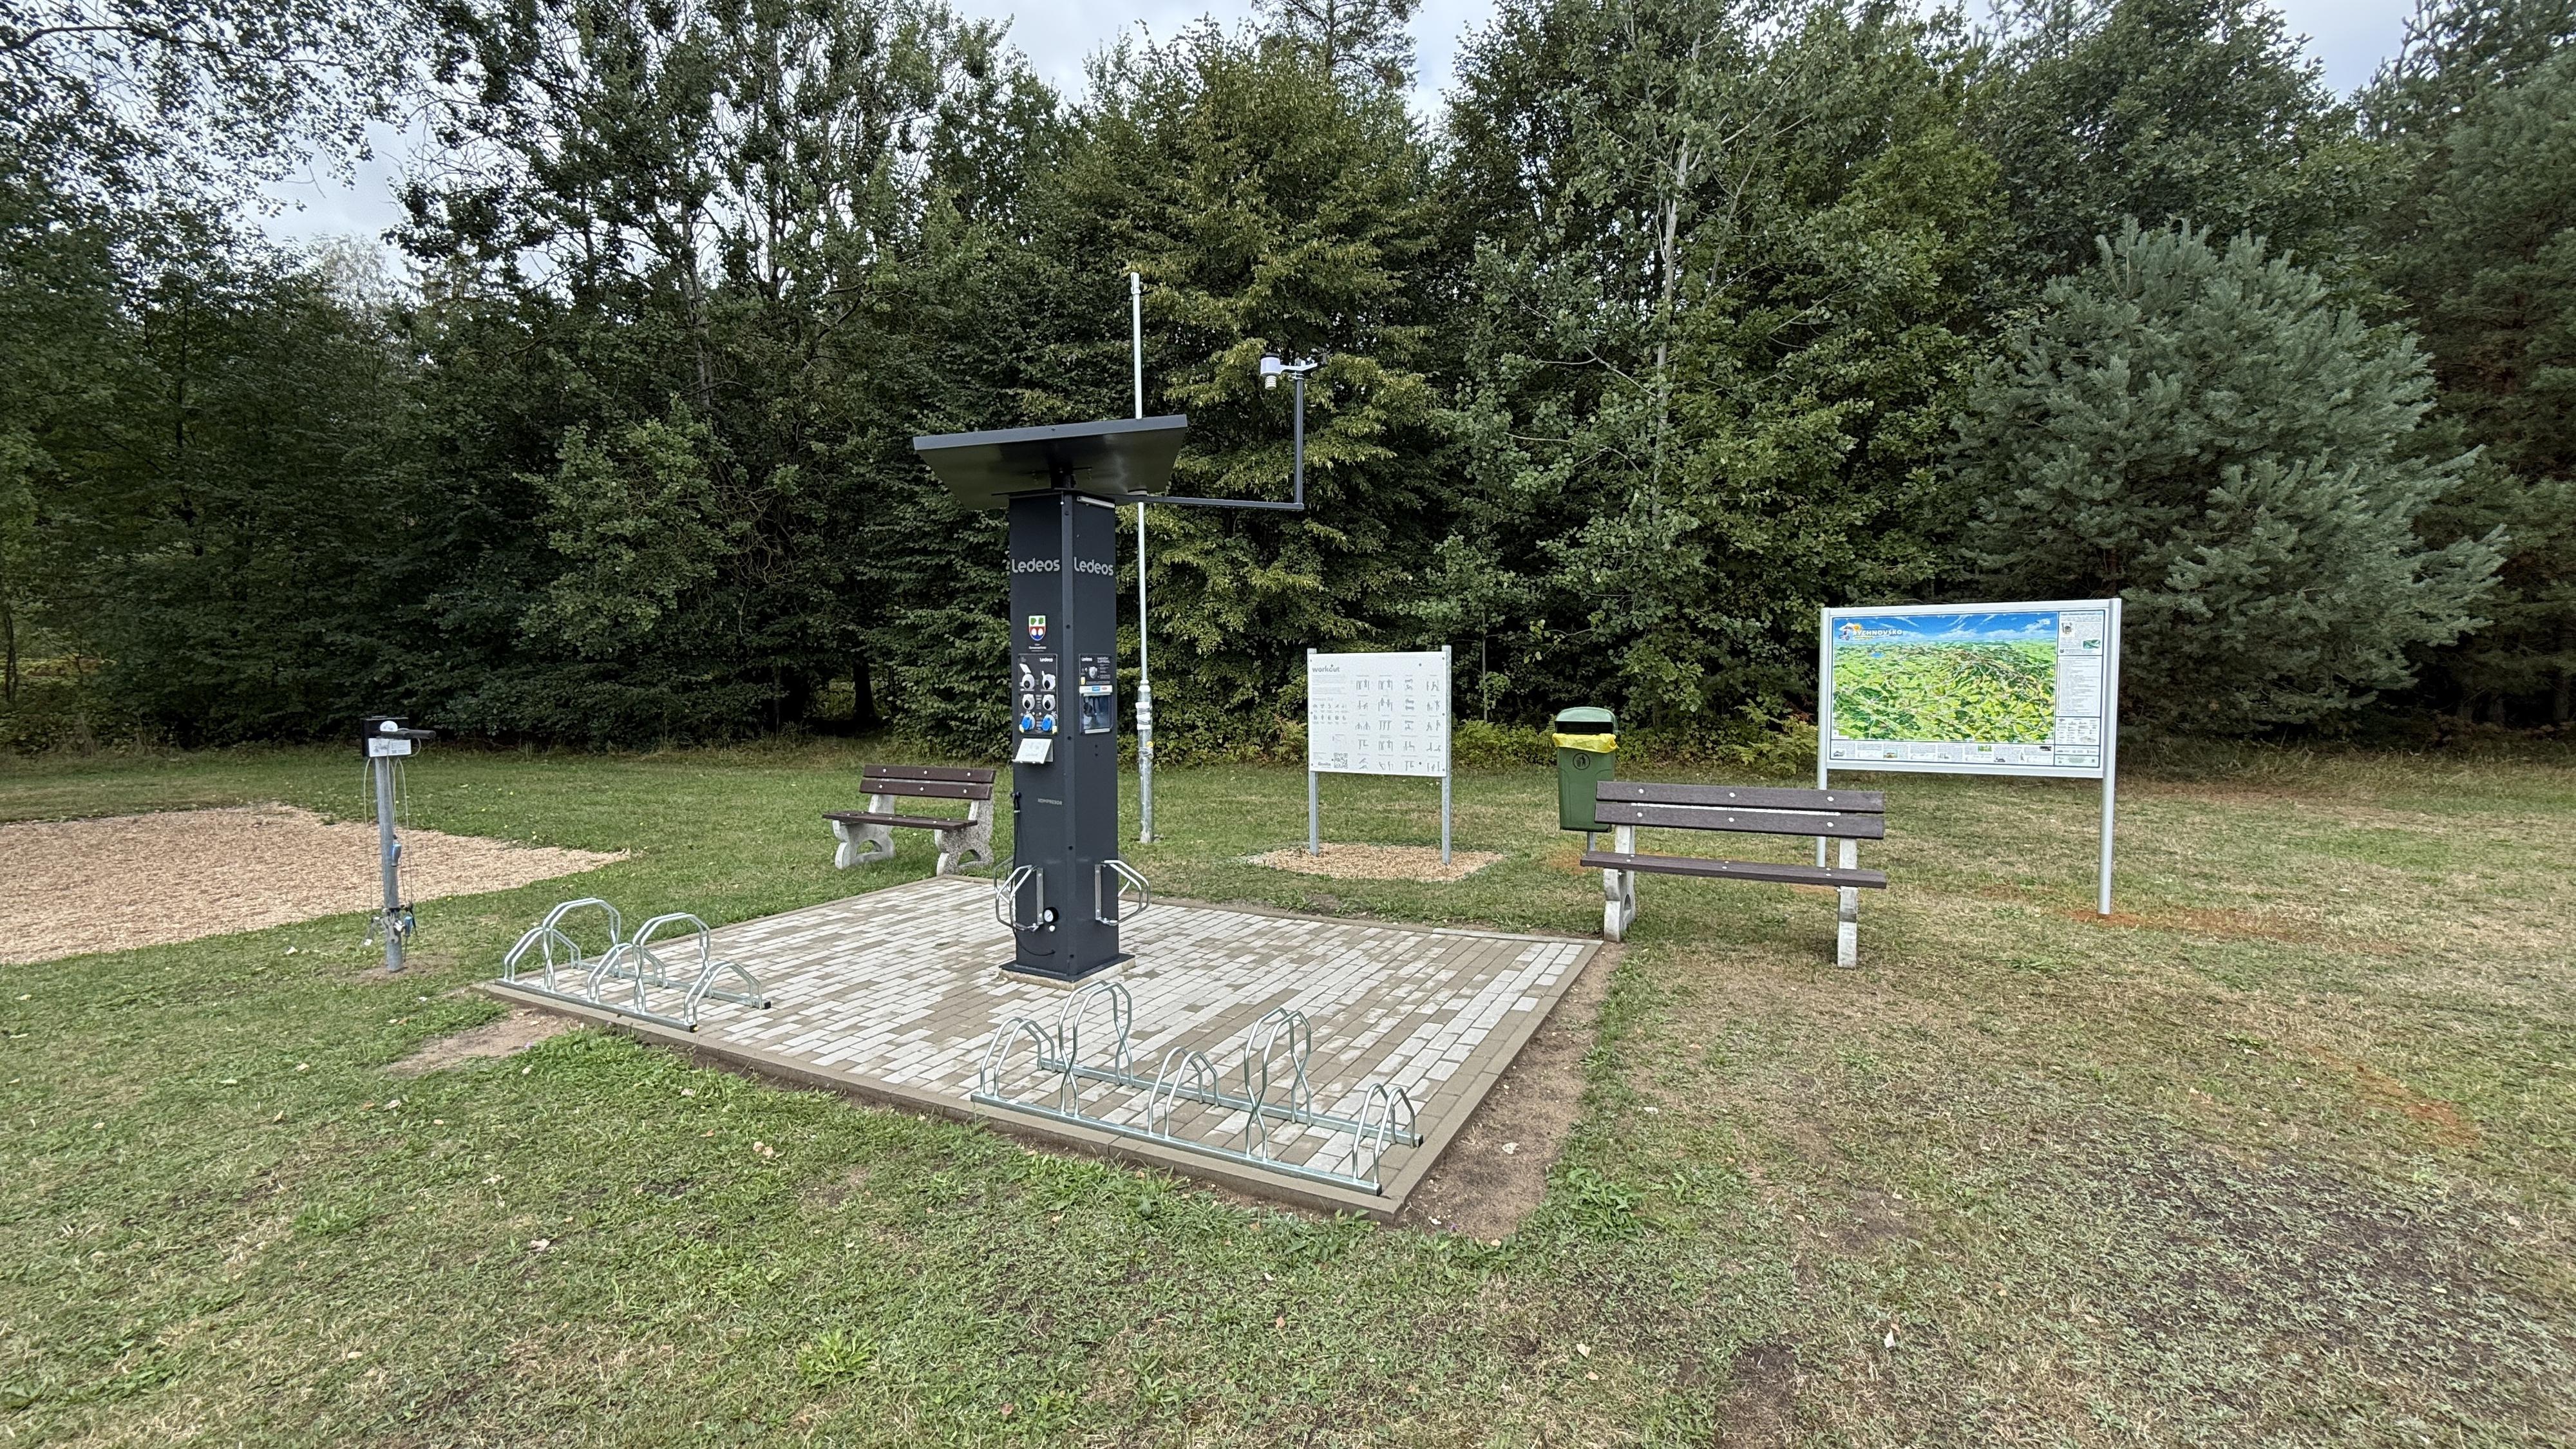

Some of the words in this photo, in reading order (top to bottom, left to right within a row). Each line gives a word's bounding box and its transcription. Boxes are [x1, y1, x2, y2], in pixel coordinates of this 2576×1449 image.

[1011, 557, 1061, 573] Ledeos
[1074, 556, 1114, 576] Ledeos
[1312, 664, 1340, 673] workout
